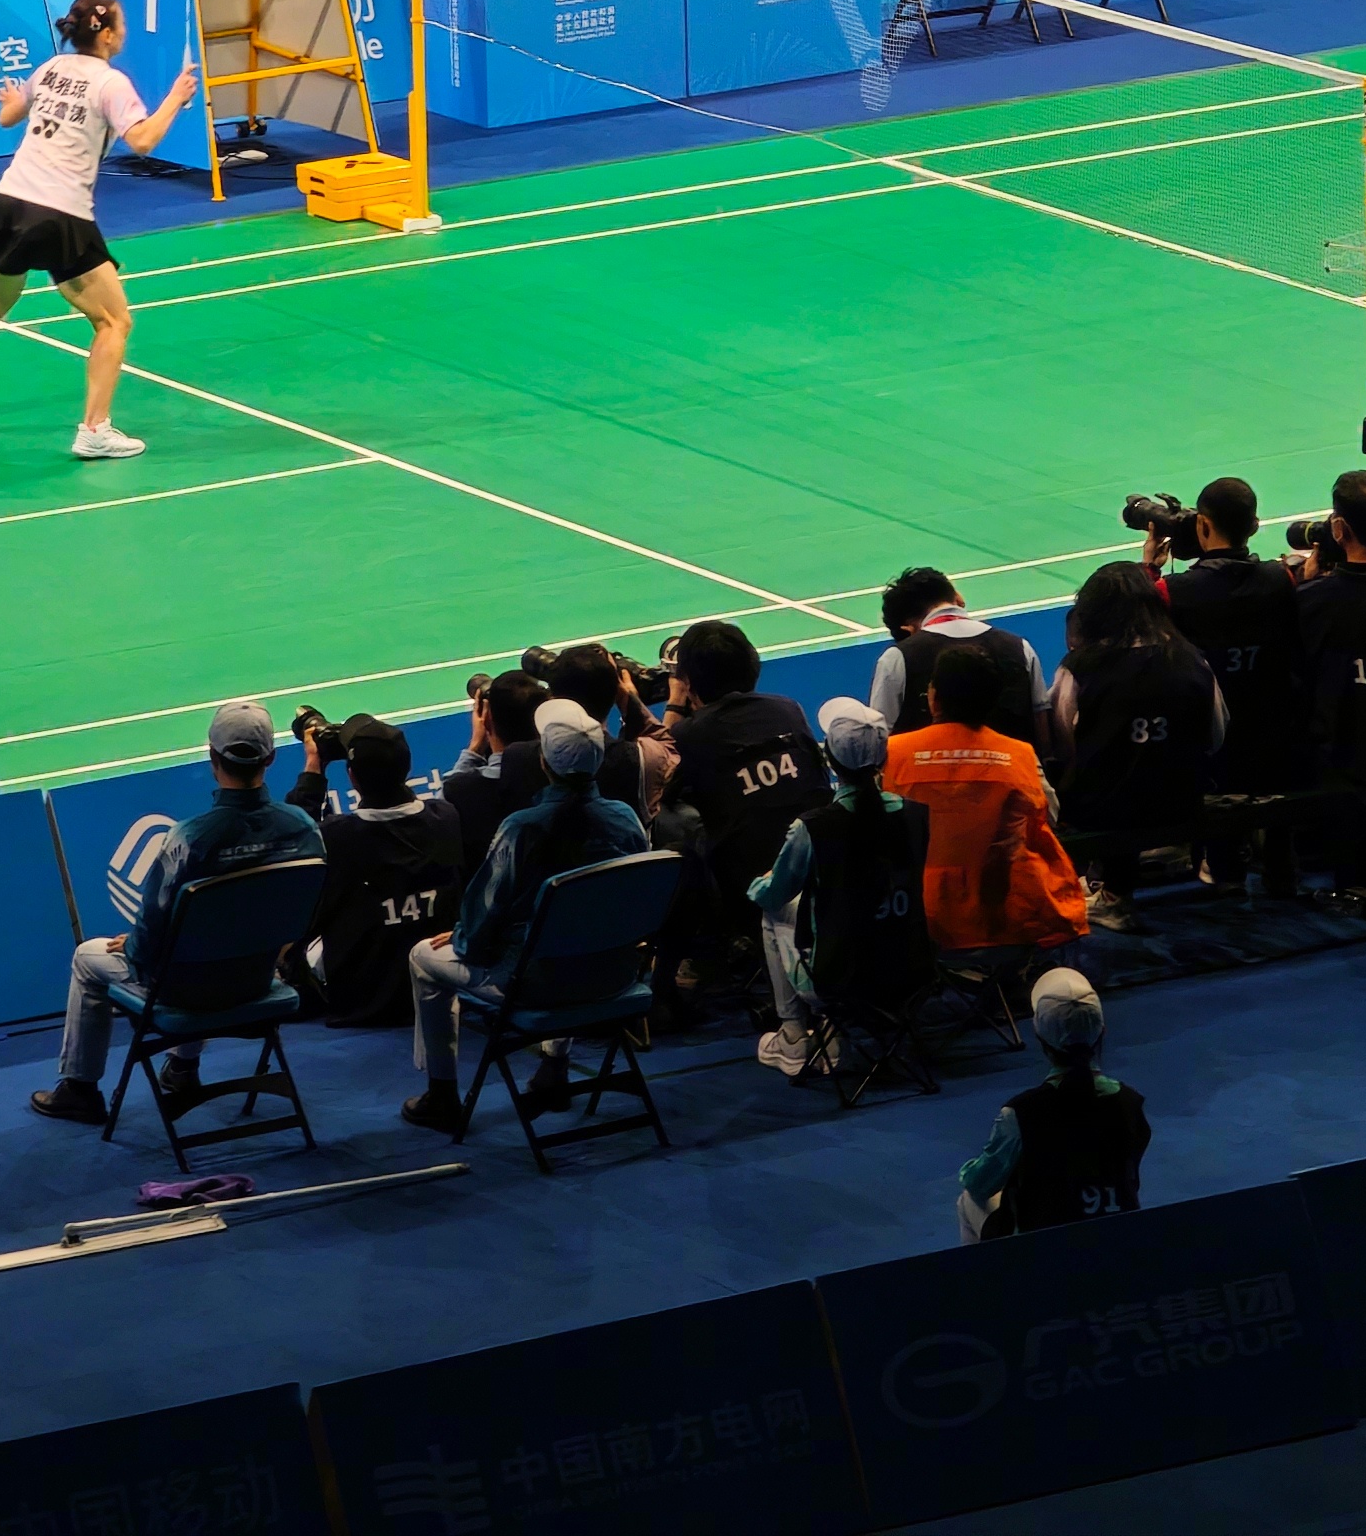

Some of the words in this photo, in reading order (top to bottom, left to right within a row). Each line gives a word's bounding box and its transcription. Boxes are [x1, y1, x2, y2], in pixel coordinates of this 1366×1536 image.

[1130, 716, 1168, 745] 83
[736, 753, 798, 796] 104
[381, 889, 438, 926] 147
[1082, 1186, 1121, 1214] 91
[1023, 1273, 1296, 1368] 广汽集团
[1024, 1358, 1125, 1401] GAC
[1134, 1320, 1303, 1377] GROUP
[500, 1389, 810, 1495] 中国南方电网
